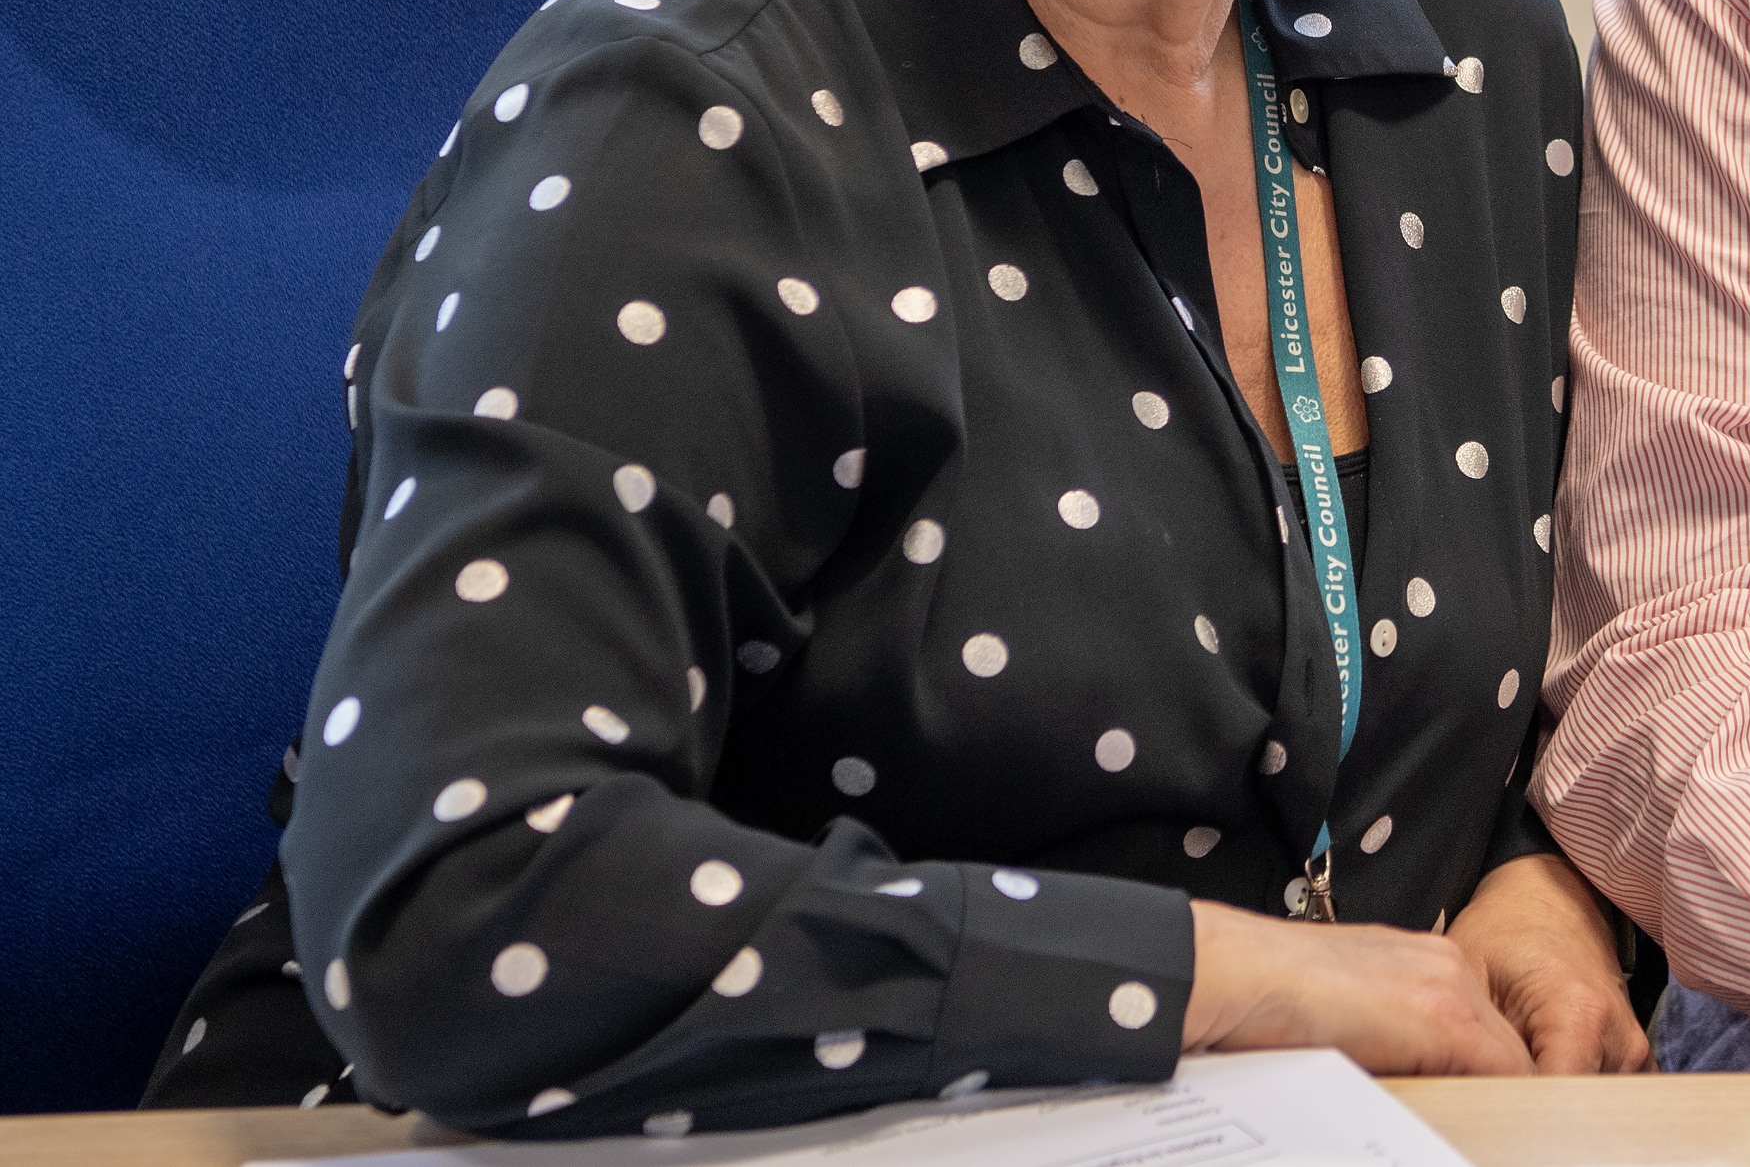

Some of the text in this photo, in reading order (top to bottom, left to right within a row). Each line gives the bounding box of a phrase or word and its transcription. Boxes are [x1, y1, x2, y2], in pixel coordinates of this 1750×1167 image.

[1256, 73, 1305, 374] Leicester City Council
[1302, 444, 1337, 548] Council
[1326, 555, 1347, 615] City
